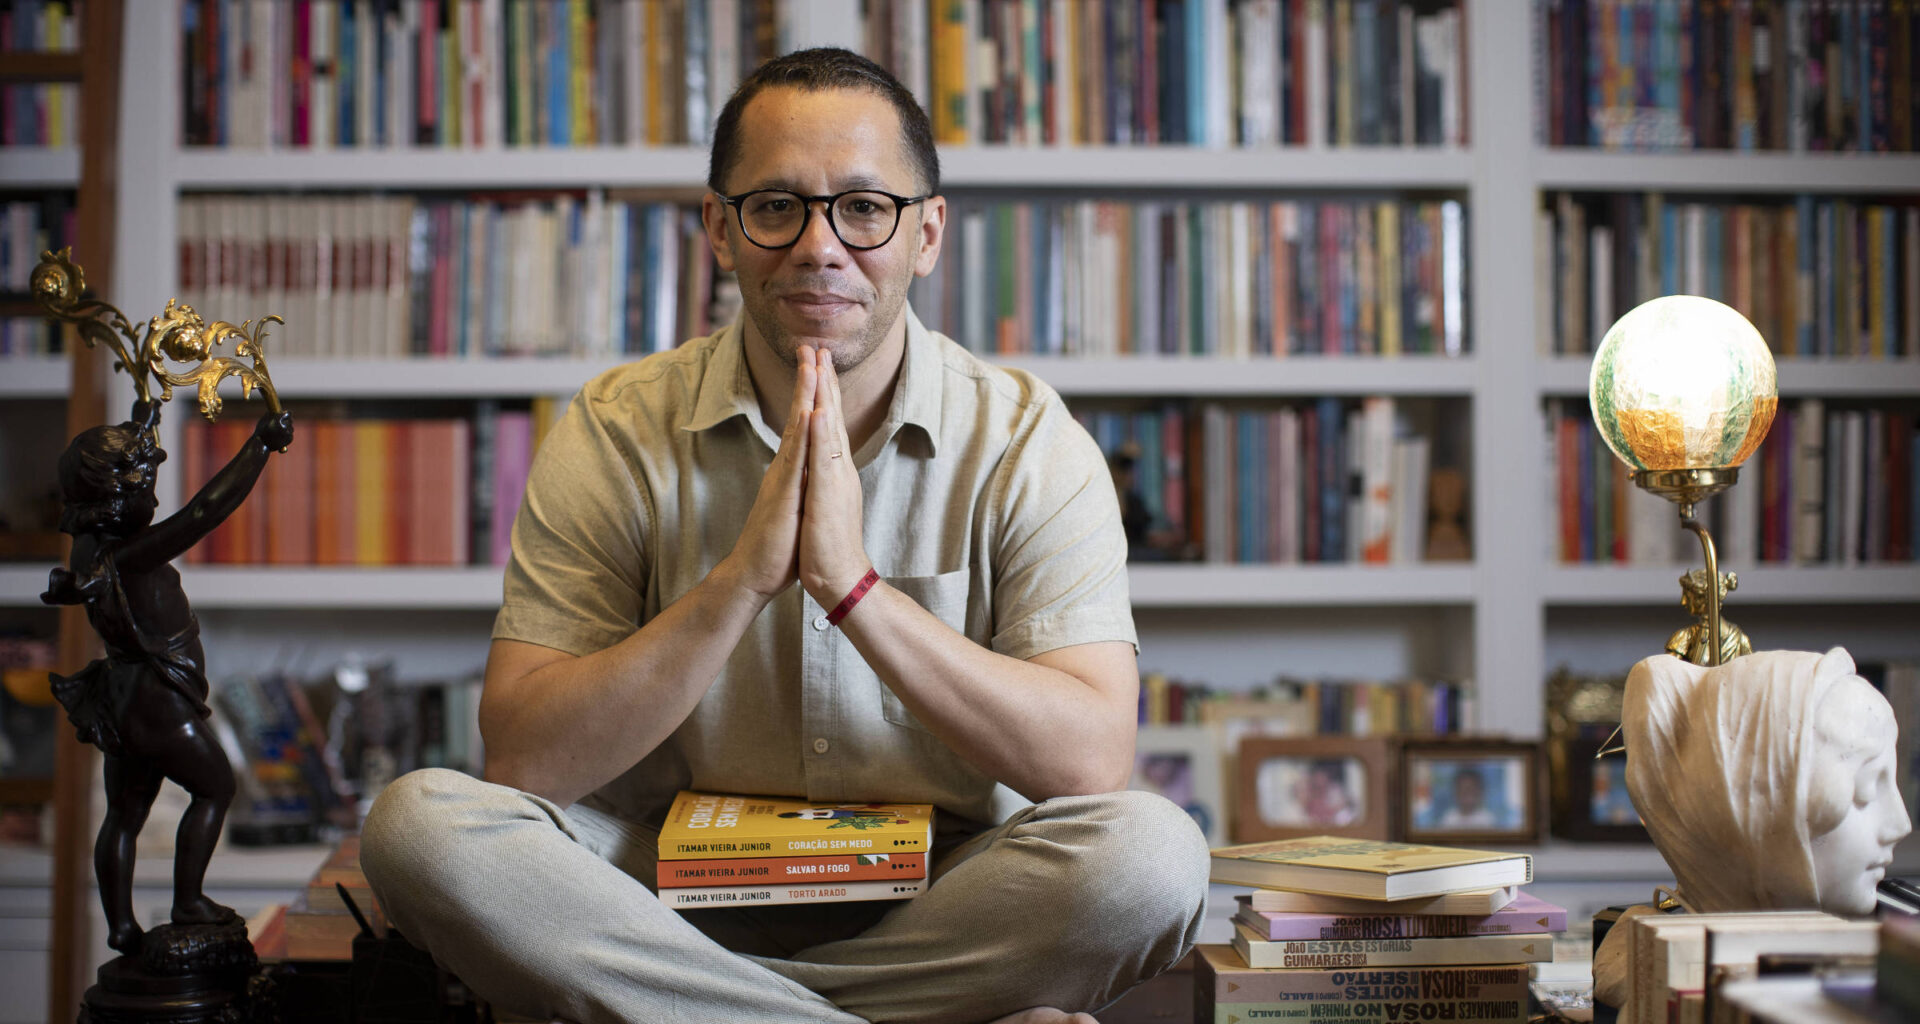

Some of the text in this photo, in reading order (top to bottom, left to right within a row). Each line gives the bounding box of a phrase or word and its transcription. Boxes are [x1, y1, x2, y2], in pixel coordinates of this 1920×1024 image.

[677, 839, 873, 853] ITAMAR VIEIRA JUNIOR CORAÇÃO SEM MEDO
[675, 864, 850, 878] ITAMAR VIEIRA JUNIOR SALVAR O FOGO
[677, 888, 847, 903] ITAMAR VIEIRA JUNIOR TORTO ARADO
[1362, 916, 1402, 938] ROSA
[1283, 940, 1412, 954] JOÃO ESTAS ESTÓRIAS
[1283, 953, 1368, 967] GUIMARÃES ROSA
[1332, 971, 1409, 986] SERTÃO
[1421, 970, 1466, 999] ROSA
[1344, 985, 1419, 1000] NOITES
[1353, 1003, 1382, 1017] NO
[1384, 1002, 1456, 1020] ROSA
[1458, 1001, 1519, 1019] GUIMARÃES
